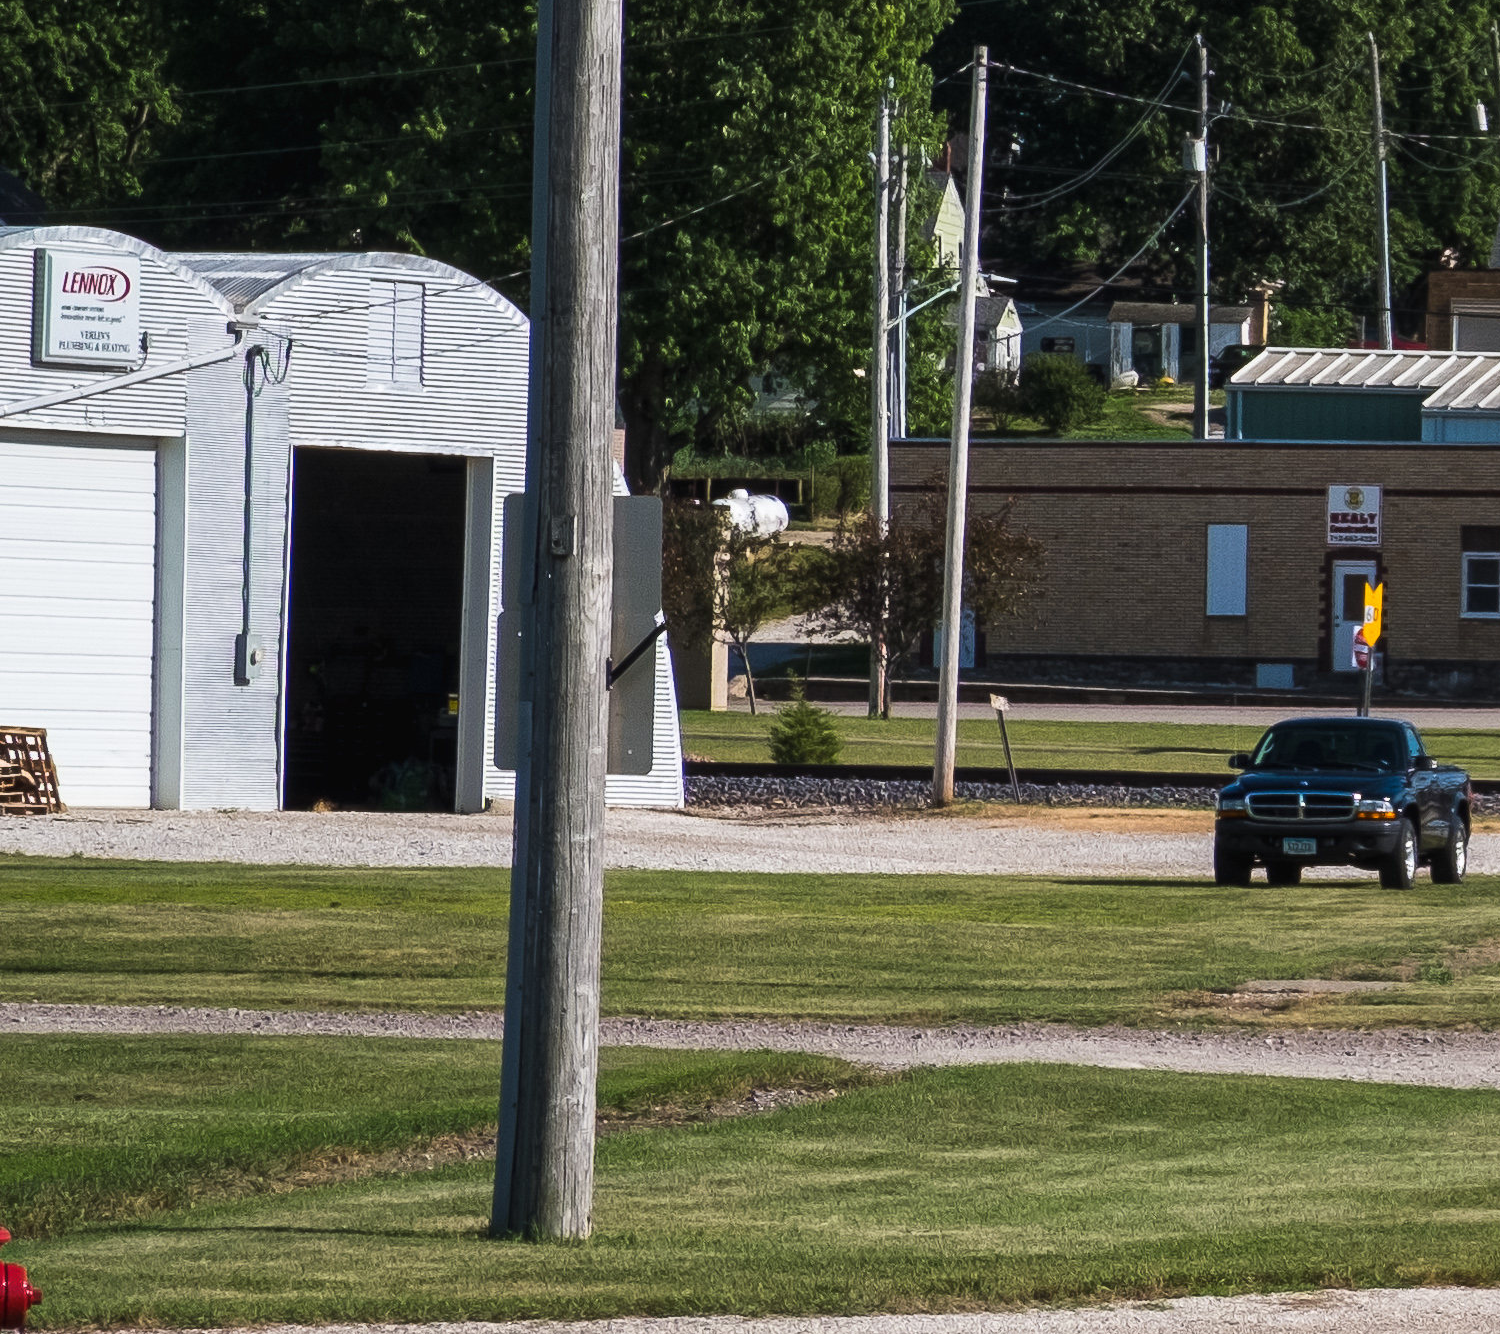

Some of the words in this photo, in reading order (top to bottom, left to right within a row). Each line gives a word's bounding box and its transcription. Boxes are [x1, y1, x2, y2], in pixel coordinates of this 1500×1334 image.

[62, 271, 118, 296] LENNOX
[58, 340, 94, 351] PLUMBING
[101, 343, 130, 353] HEATING
